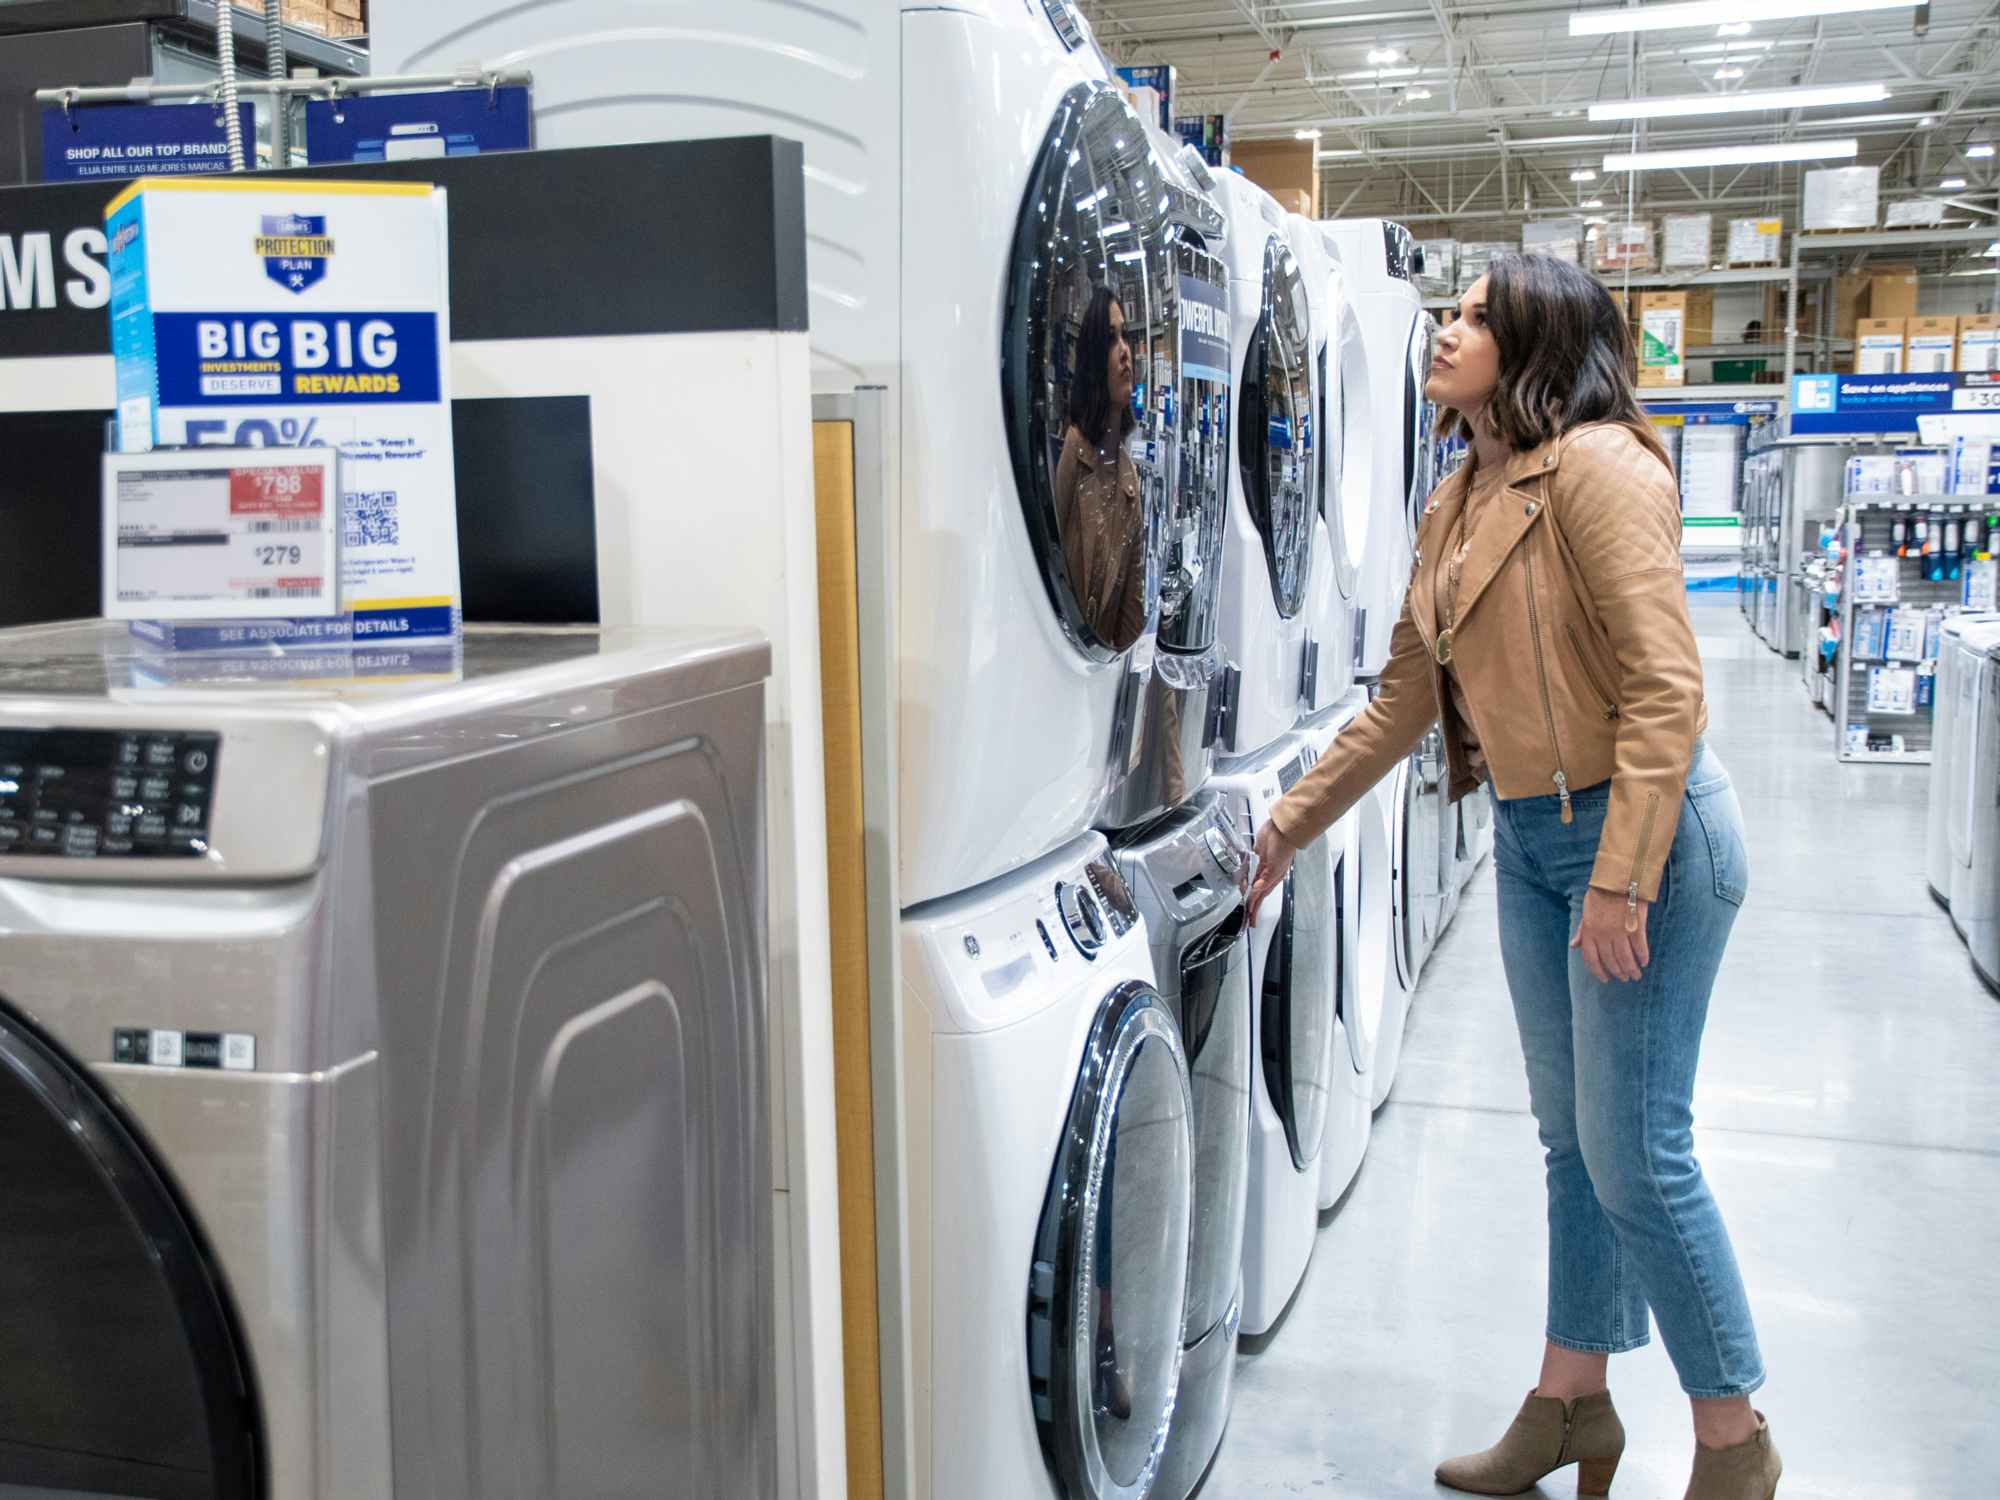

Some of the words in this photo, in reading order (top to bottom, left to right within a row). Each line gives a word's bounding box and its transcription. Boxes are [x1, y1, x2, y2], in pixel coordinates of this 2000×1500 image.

[67, 149, 99, 160] SHOP
[102, 147, 124, 158] ALL
[127, 146, 153, 157] OUR
[156, 145, 181, 156] TOP
[103, 165, 128, 174] ENTRE
[130, 164, 146, 173] LAS
[149, 163, 186, 173] MEJORES
[255, 238, 335, 255] PROTECTION
[281, 260, 313, 270] PLAN
[198, 320, 281, 358] BIG
[292, 320, 398, 368] BIG
[201, 363, 281, 373] INVESTMENTS
[210, 379, 274, 391] DESERVE
[294, 374, 400, 393] REWARDS
[1841, 384, 1869, 394] Save
[1870, 385, 1886, 393] on
[1887, 382, 1949, 394] appliances
[255, 475, 301, 495] $798
[256, 546, 301, 565] $279
[220, 630, 244, 641] SEE
[249, 626, 320, 639] ASSOCIATE
[325, 623, 352, 635] FOR
[356, 619, 409, 633] DETAILS
